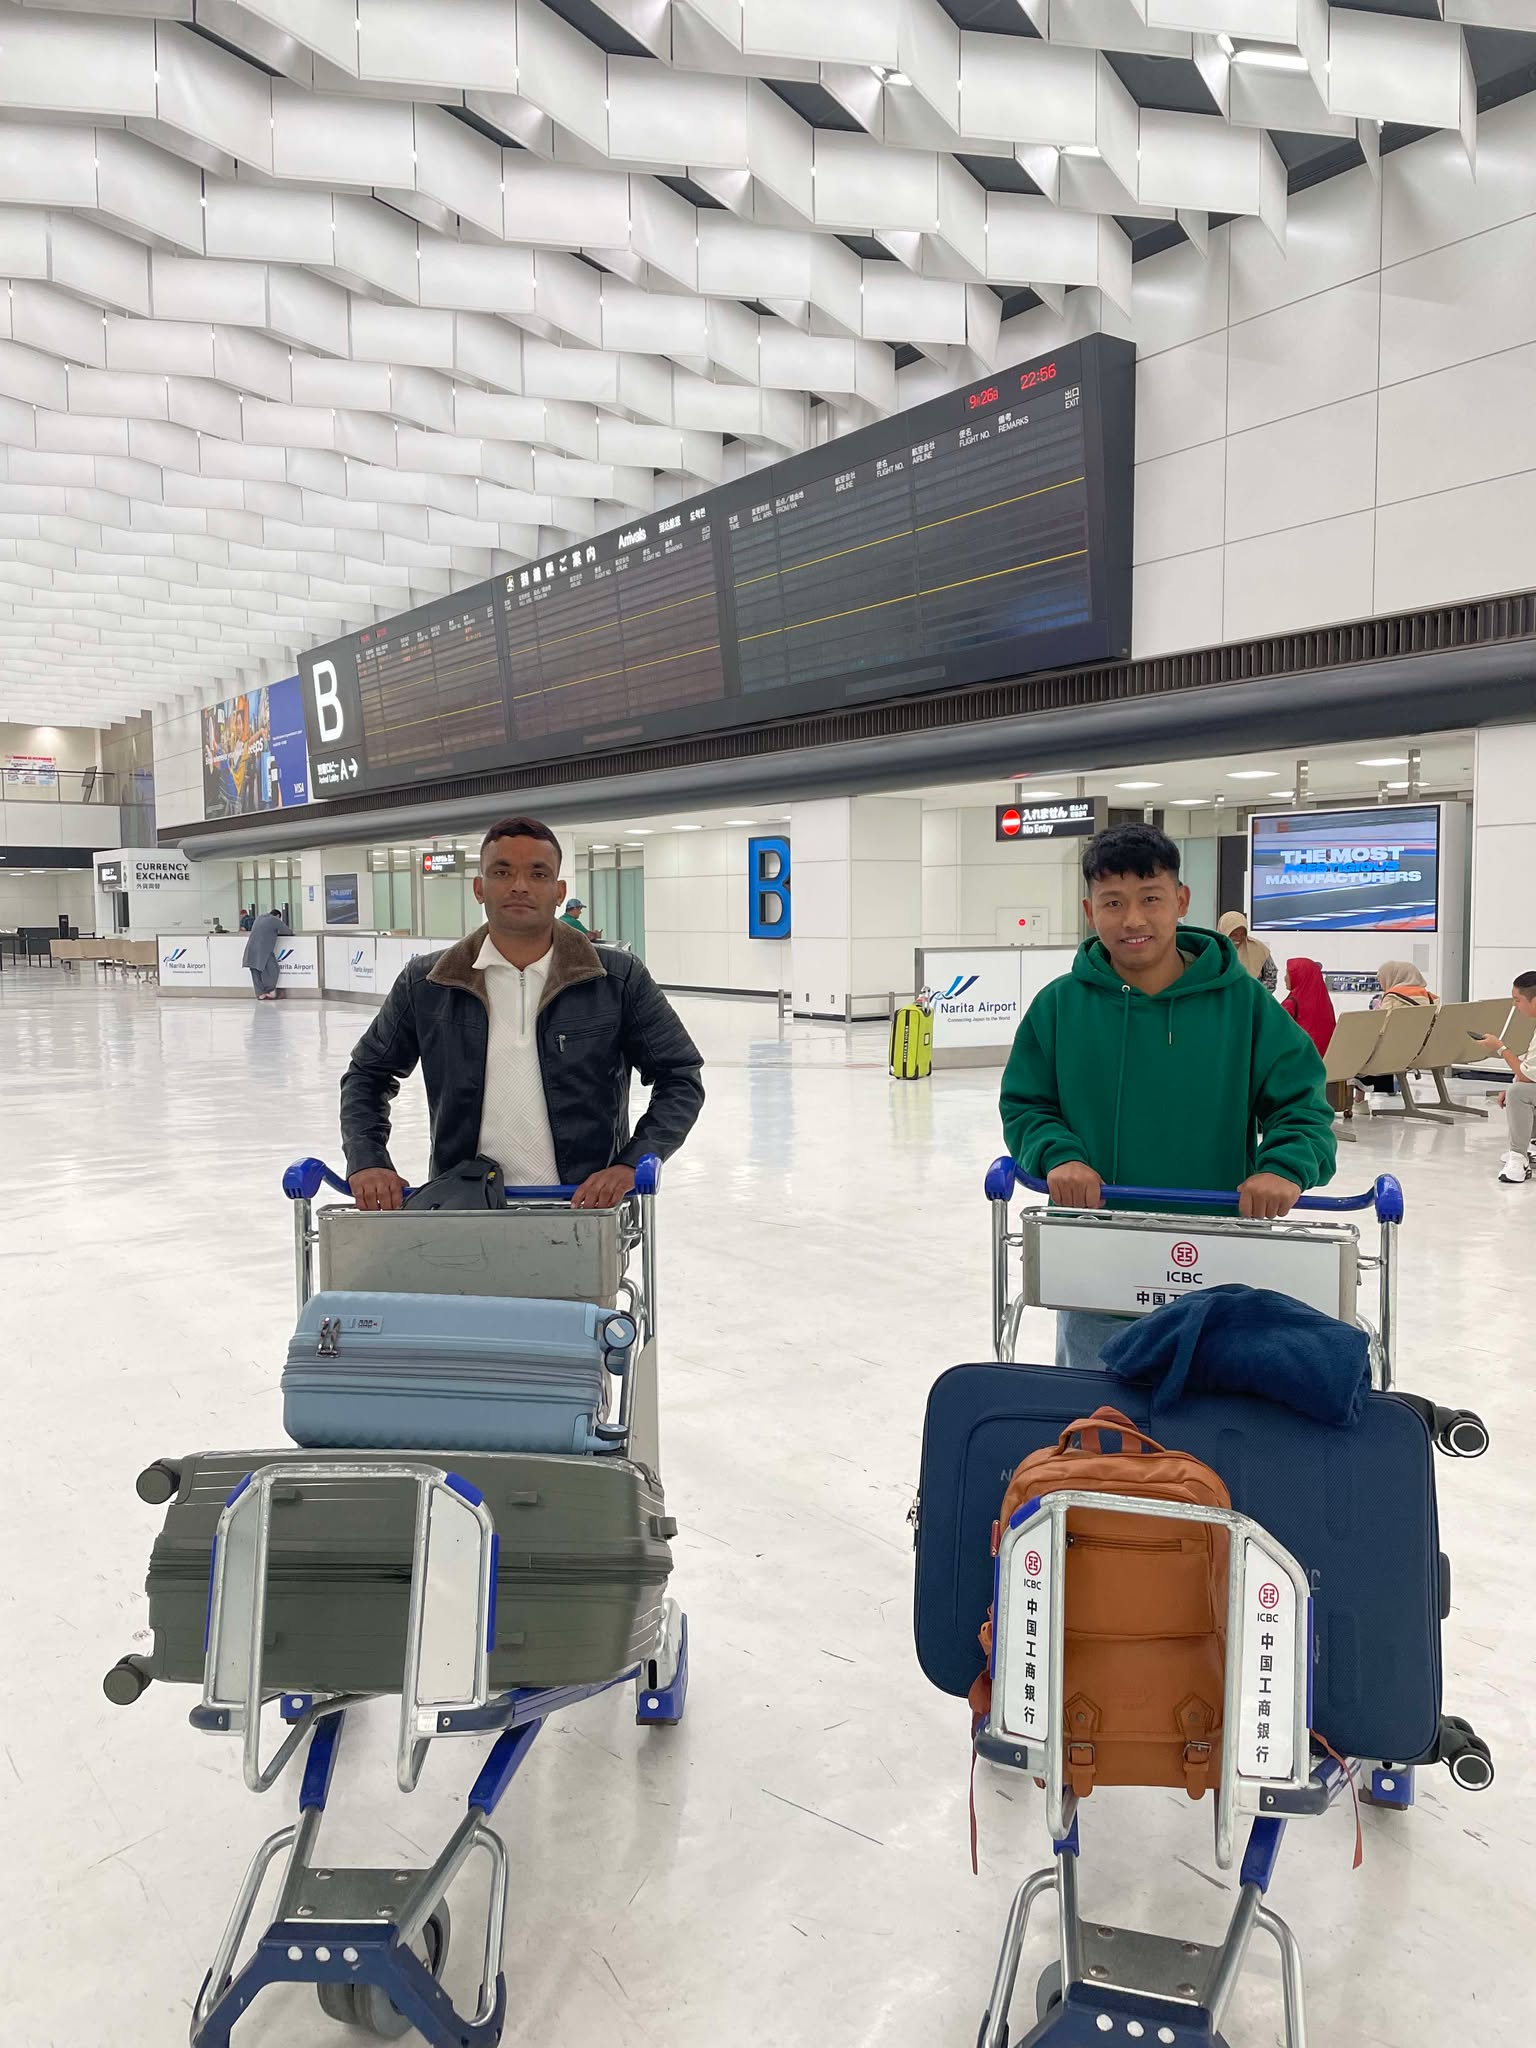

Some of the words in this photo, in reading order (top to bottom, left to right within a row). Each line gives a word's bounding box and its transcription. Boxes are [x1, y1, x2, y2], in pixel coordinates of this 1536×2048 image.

[1020, 363, 1056, 390] 22:56
[1064, 387, 1079, 400] 出口
[1065, 397, 1079, 409] EXIT
[998, 415, 1029, 434] REMARKS
[959, 434, 980, 448] FLIGHT
[980, 430, 990, 440] NO.
[912, 450, 933, 465] AIRLINE
[876, 465, 894, 478] FLIGHT
[618, 527, 647, 550] Arrivals
[312, 659, 344, 743] B
[340, 758, 349, 781] A
[1022, 807, 1068, 821] 入れません
[1023, 825, 1033, 834] No
[1034, 824, 1054, 835] Entry
[1281, 849, 1327, 863] THE
[1331, 846, 1404, 864] MOST
[136, 862, 188, 871] CURRENCY
[136, 872, 190, 881] EXCHANGE
[1266, 871, 1422, 885] MANUFACTURERS
[748, 835, 791, 940] B
[293, 963, 314, 971] Airport
[941, 1002, 974, 1013] Narita
[978, 1001, 1016, 1014] Airport
[1166, 1271, 1203, 1284] ICBC
[1023, 1578, 1042, 1591] ICBC
[1257, 1612, 1279, 1623] ICBC
[1024, 1598, 1038, 1725] 中国工商银行
[1255, 1632, 1274, 1764] 中国工商银行
